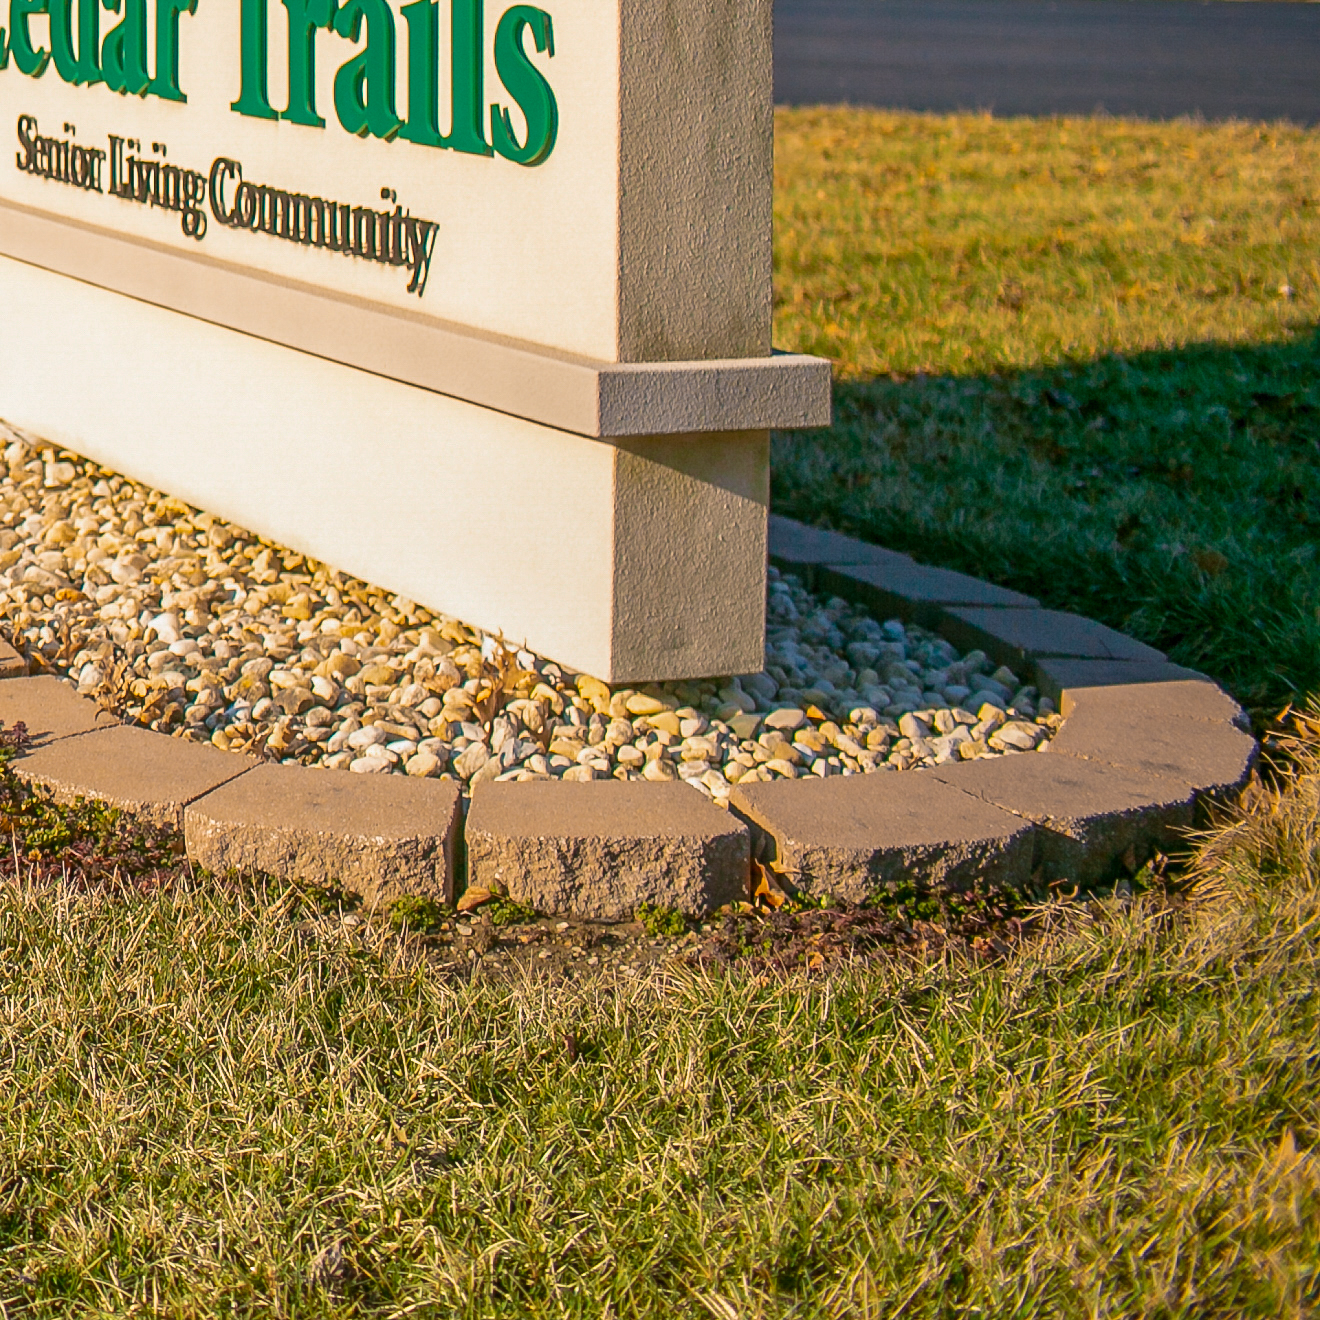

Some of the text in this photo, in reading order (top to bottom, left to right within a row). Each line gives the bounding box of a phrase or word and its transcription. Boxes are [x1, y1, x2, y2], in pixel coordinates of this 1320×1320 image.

[16, 113, 440, 297] Senior Living Community
